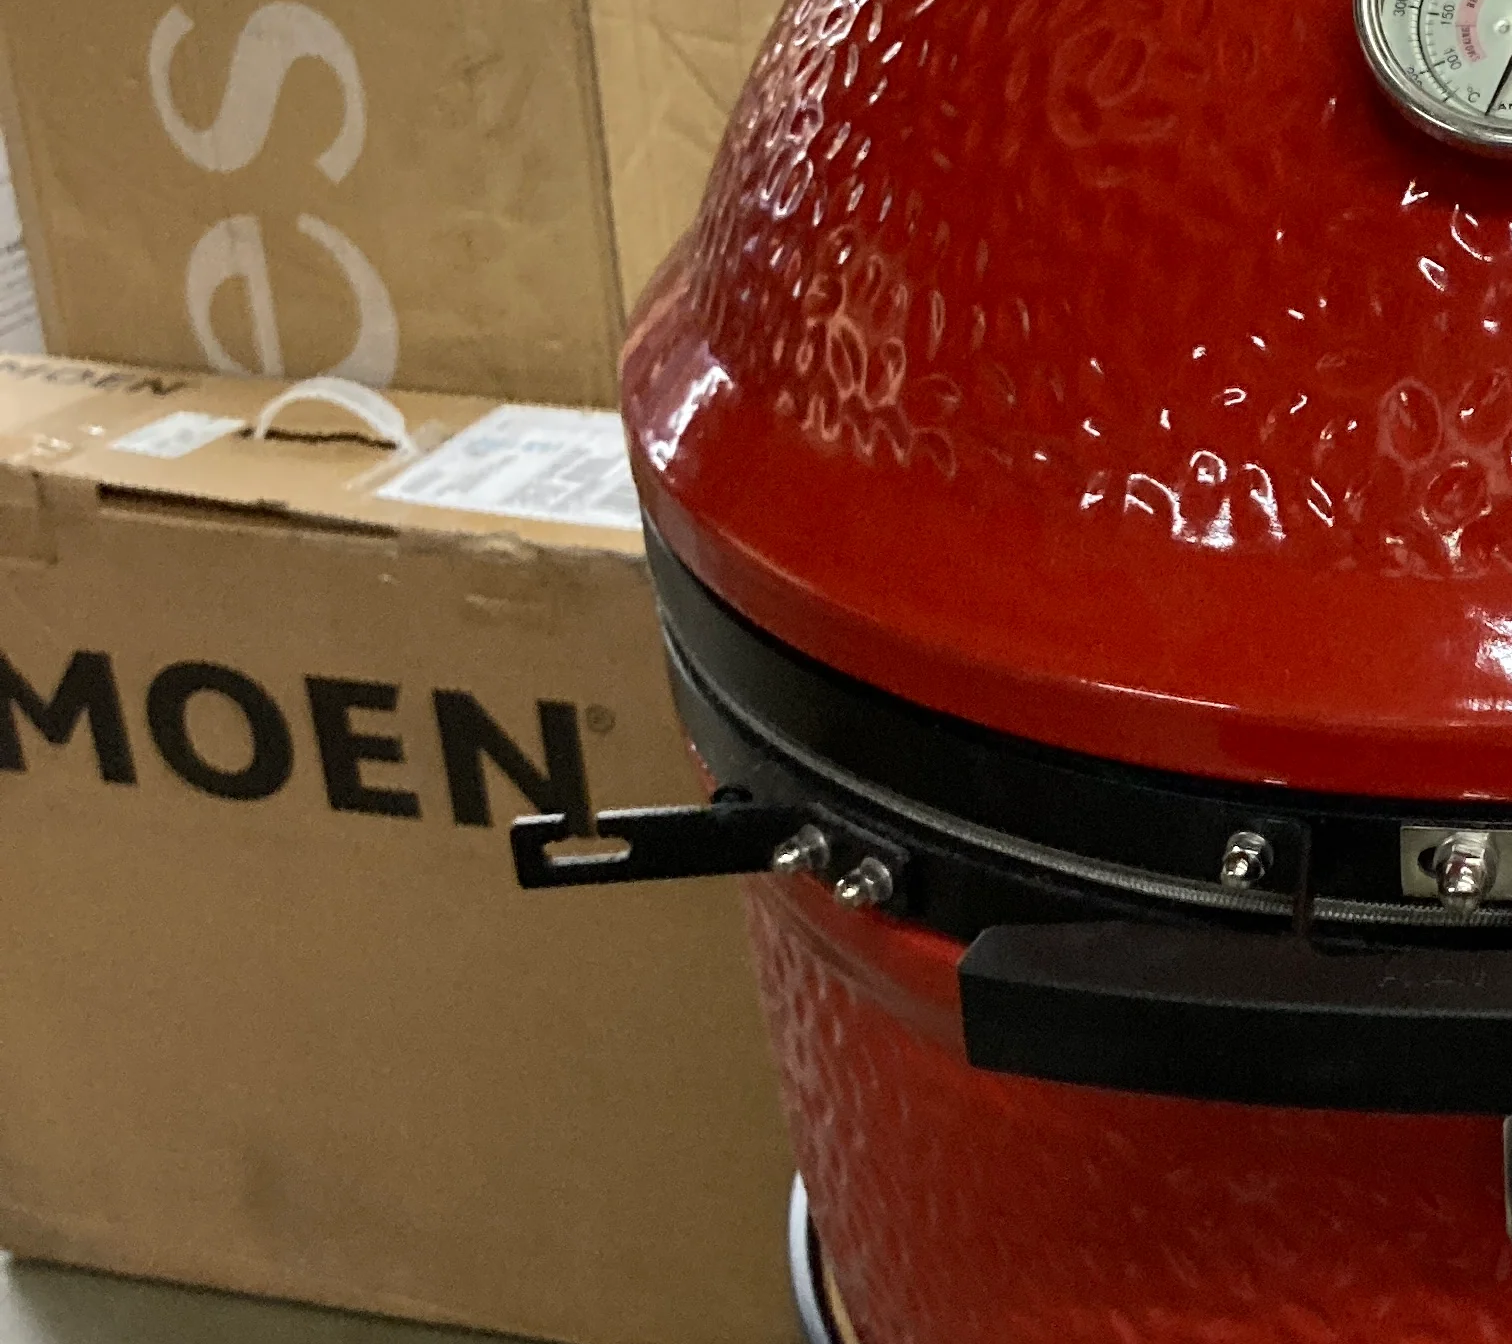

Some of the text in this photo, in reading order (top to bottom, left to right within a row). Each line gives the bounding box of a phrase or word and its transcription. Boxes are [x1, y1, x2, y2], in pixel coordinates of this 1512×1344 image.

[1440, 4, 1455, 25] 150
[1443, 48, 1463, 71] 100
[0, 650, 600, 837] MOEN
